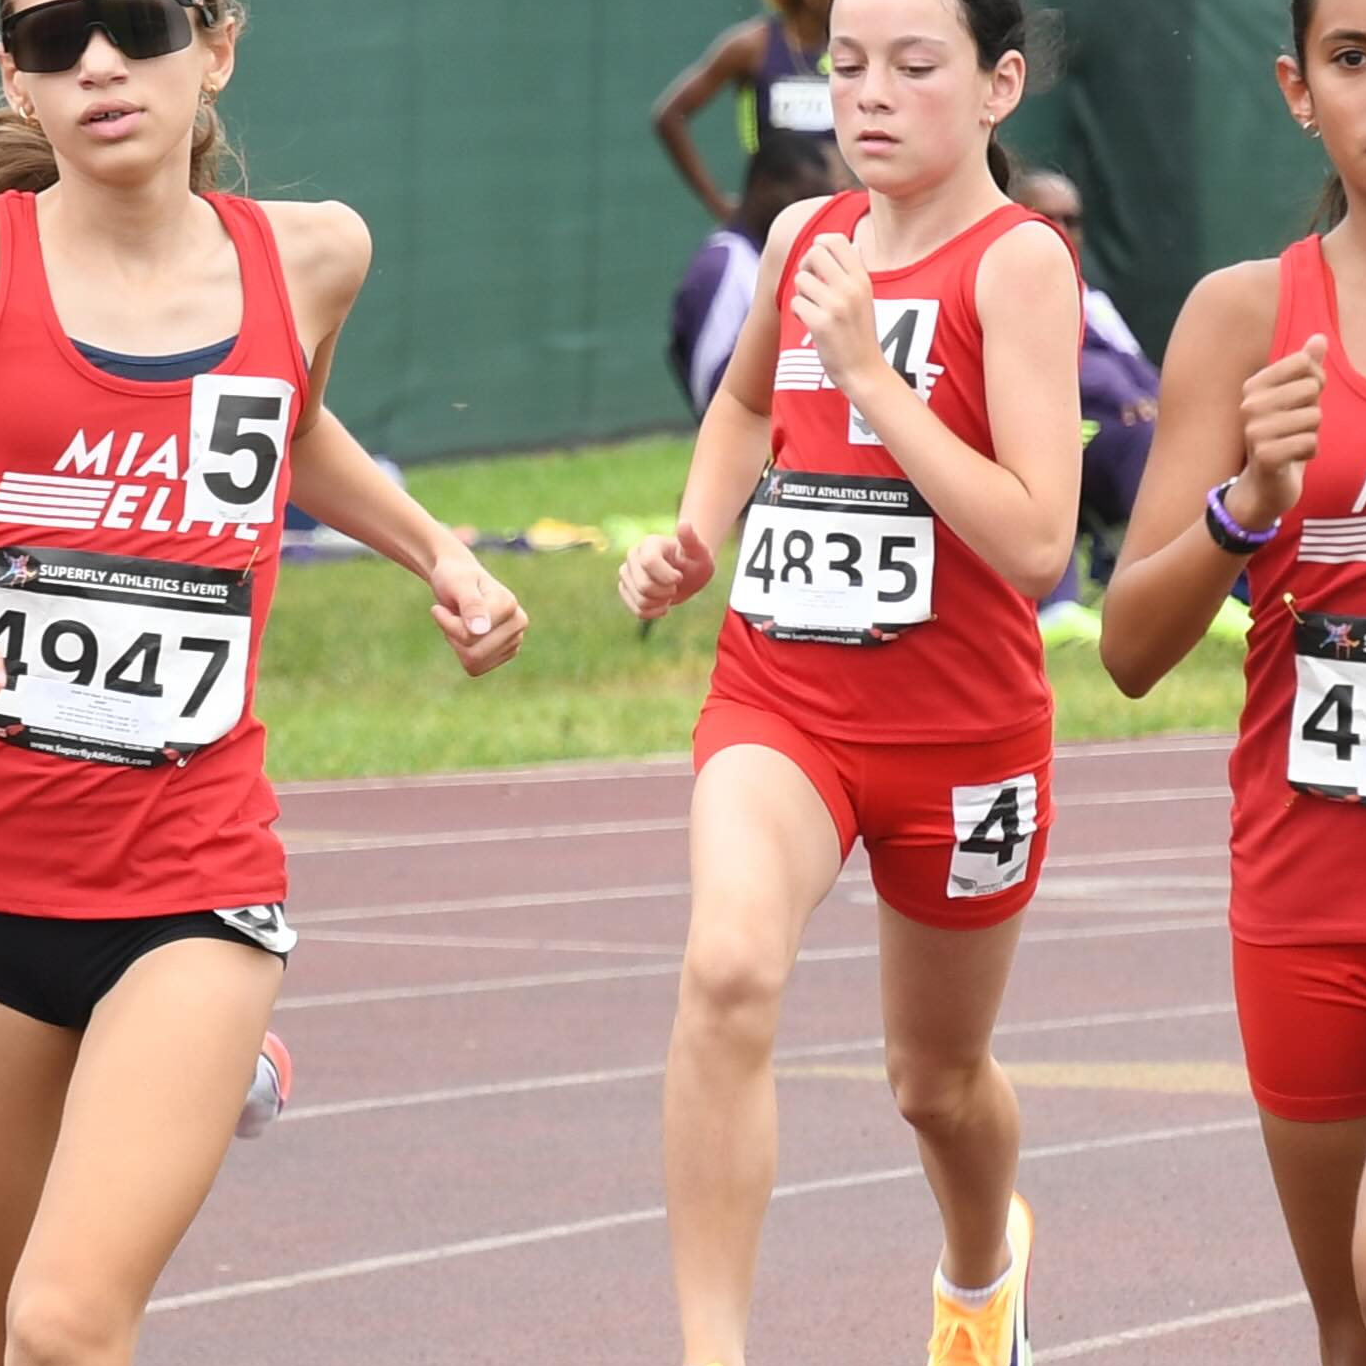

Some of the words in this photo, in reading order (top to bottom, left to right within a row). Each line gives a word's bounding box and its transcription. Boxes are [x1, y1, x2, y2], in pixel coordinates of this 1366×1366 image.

[53, 429, 188, 480] MIA
[202, 394, 282, 505] 5
[817, 486, 867, 500] ATHLETICS
[869, 490, 910, 502] EVENTS
[39, 564, 108, 583] SUPERFLY
[109, 571, 180, 592] ATHLETICS
[182, 581, 230, 597] EVENTS
[744, 527, 918, 603] 4835
[958, 786, 1027, 867] 4
